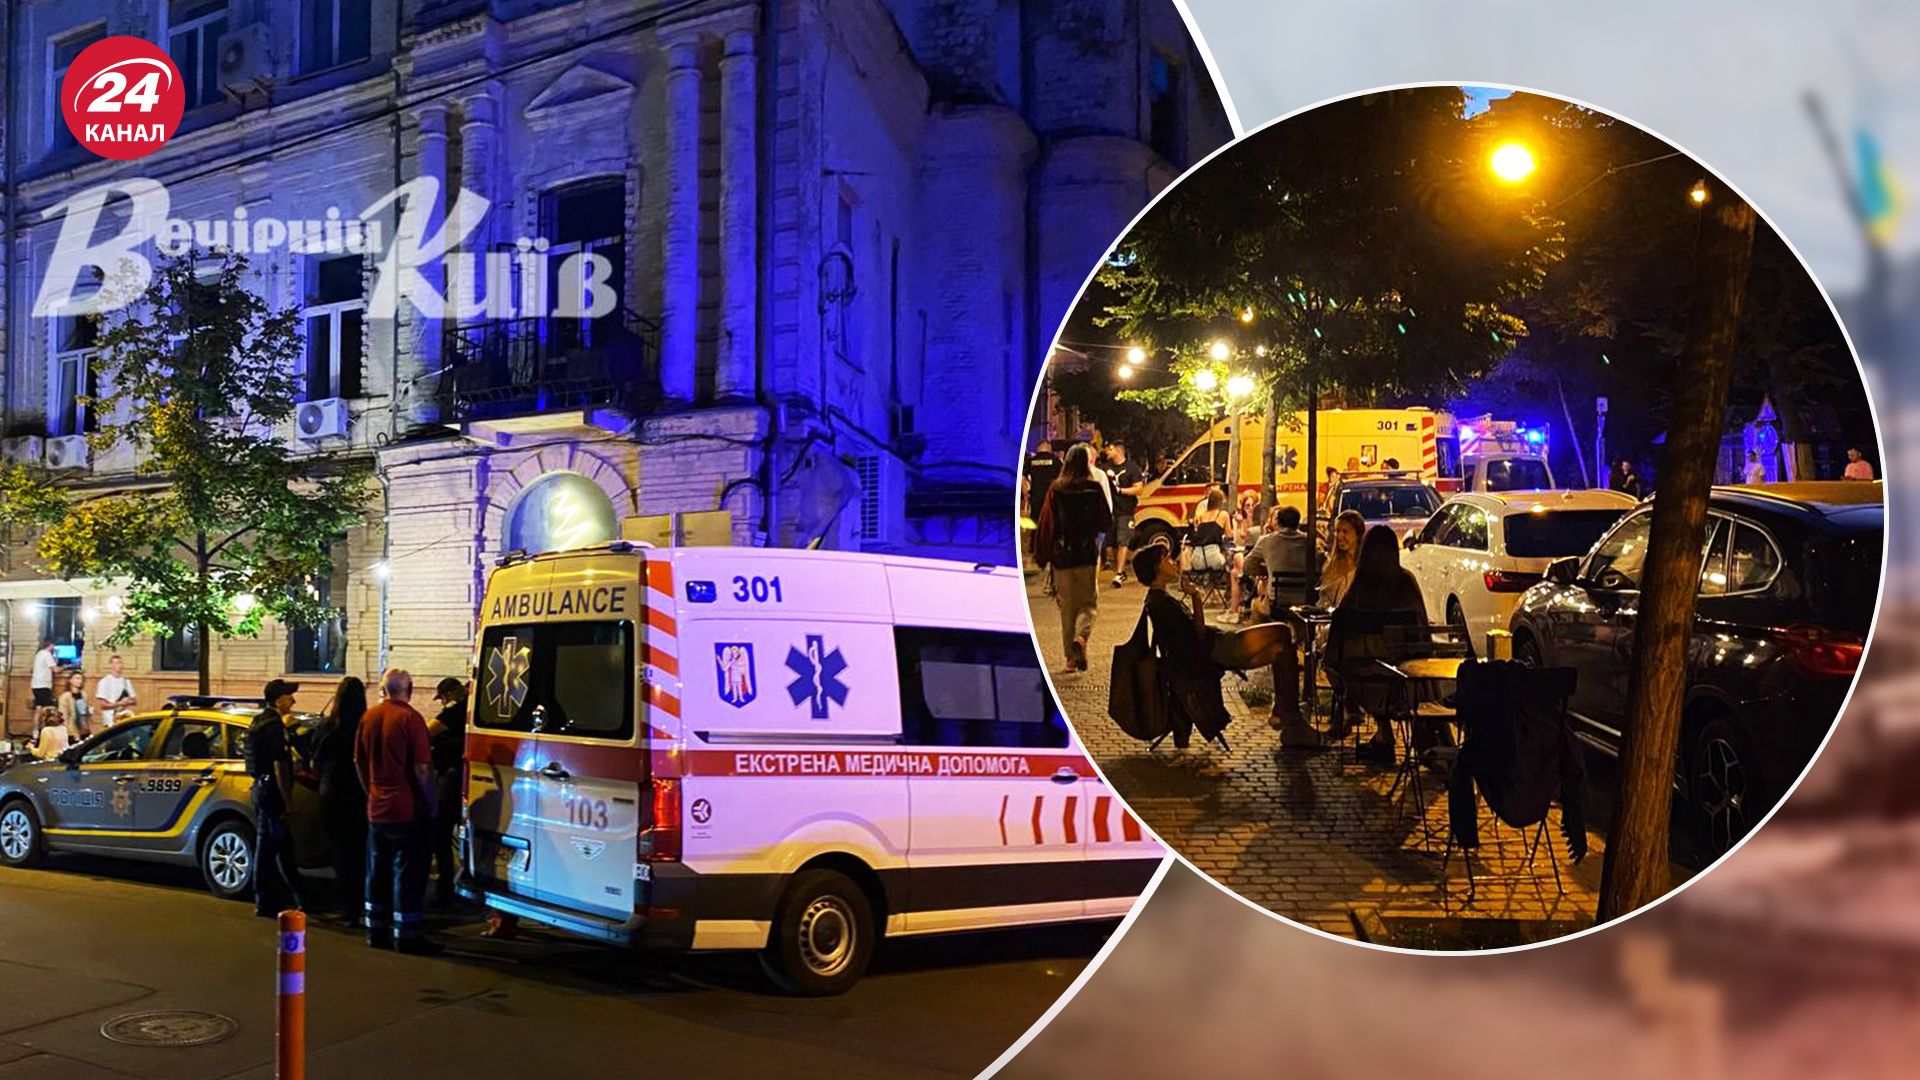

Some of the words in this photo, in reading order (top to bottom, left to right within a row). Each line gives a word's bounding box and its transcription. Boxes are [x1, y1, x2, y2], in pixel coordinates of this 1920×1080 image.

[1377, 420, 1398, 430] 301
[491, 585, 627, 619] AMBULANCE
[732, 575, 783, 603] 301
[735, 754, 840, 774] ЕКСТРЕНА
[844, 754, 933, 775] МЕДИЧНА
[937, 755, 1030, 777] ДОПОМОГА
[564, 796, 609, 832] 103
